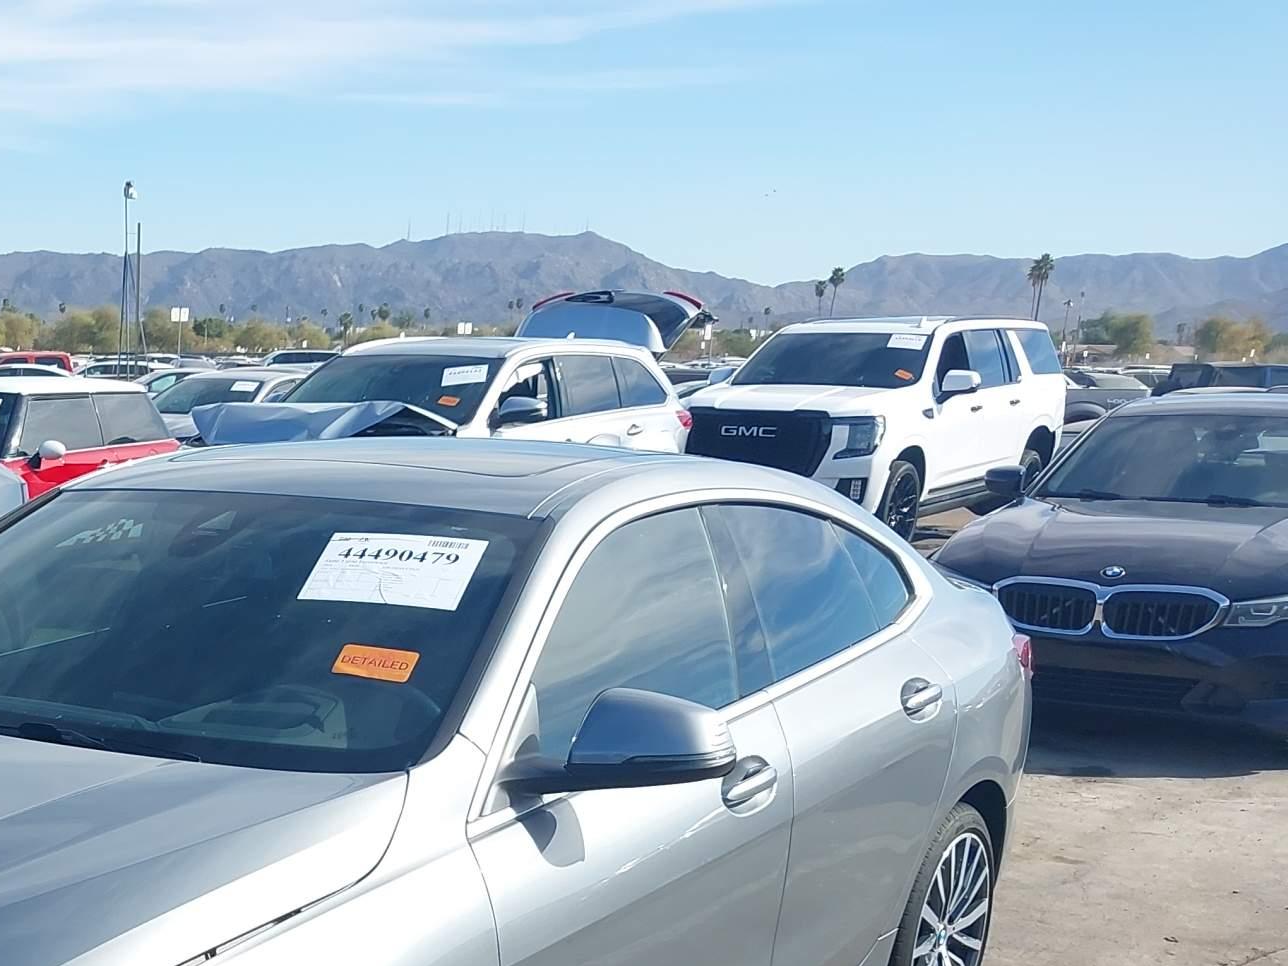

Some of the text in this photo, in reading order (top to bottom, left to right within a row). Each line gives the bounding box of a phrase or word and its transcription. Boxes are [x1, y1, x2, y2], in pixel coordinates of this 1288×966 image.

[721, 425, 777, 437] GMC
[338, 547, 460, 566] 44490479
[340, 655, 409, 671] DETAILED
